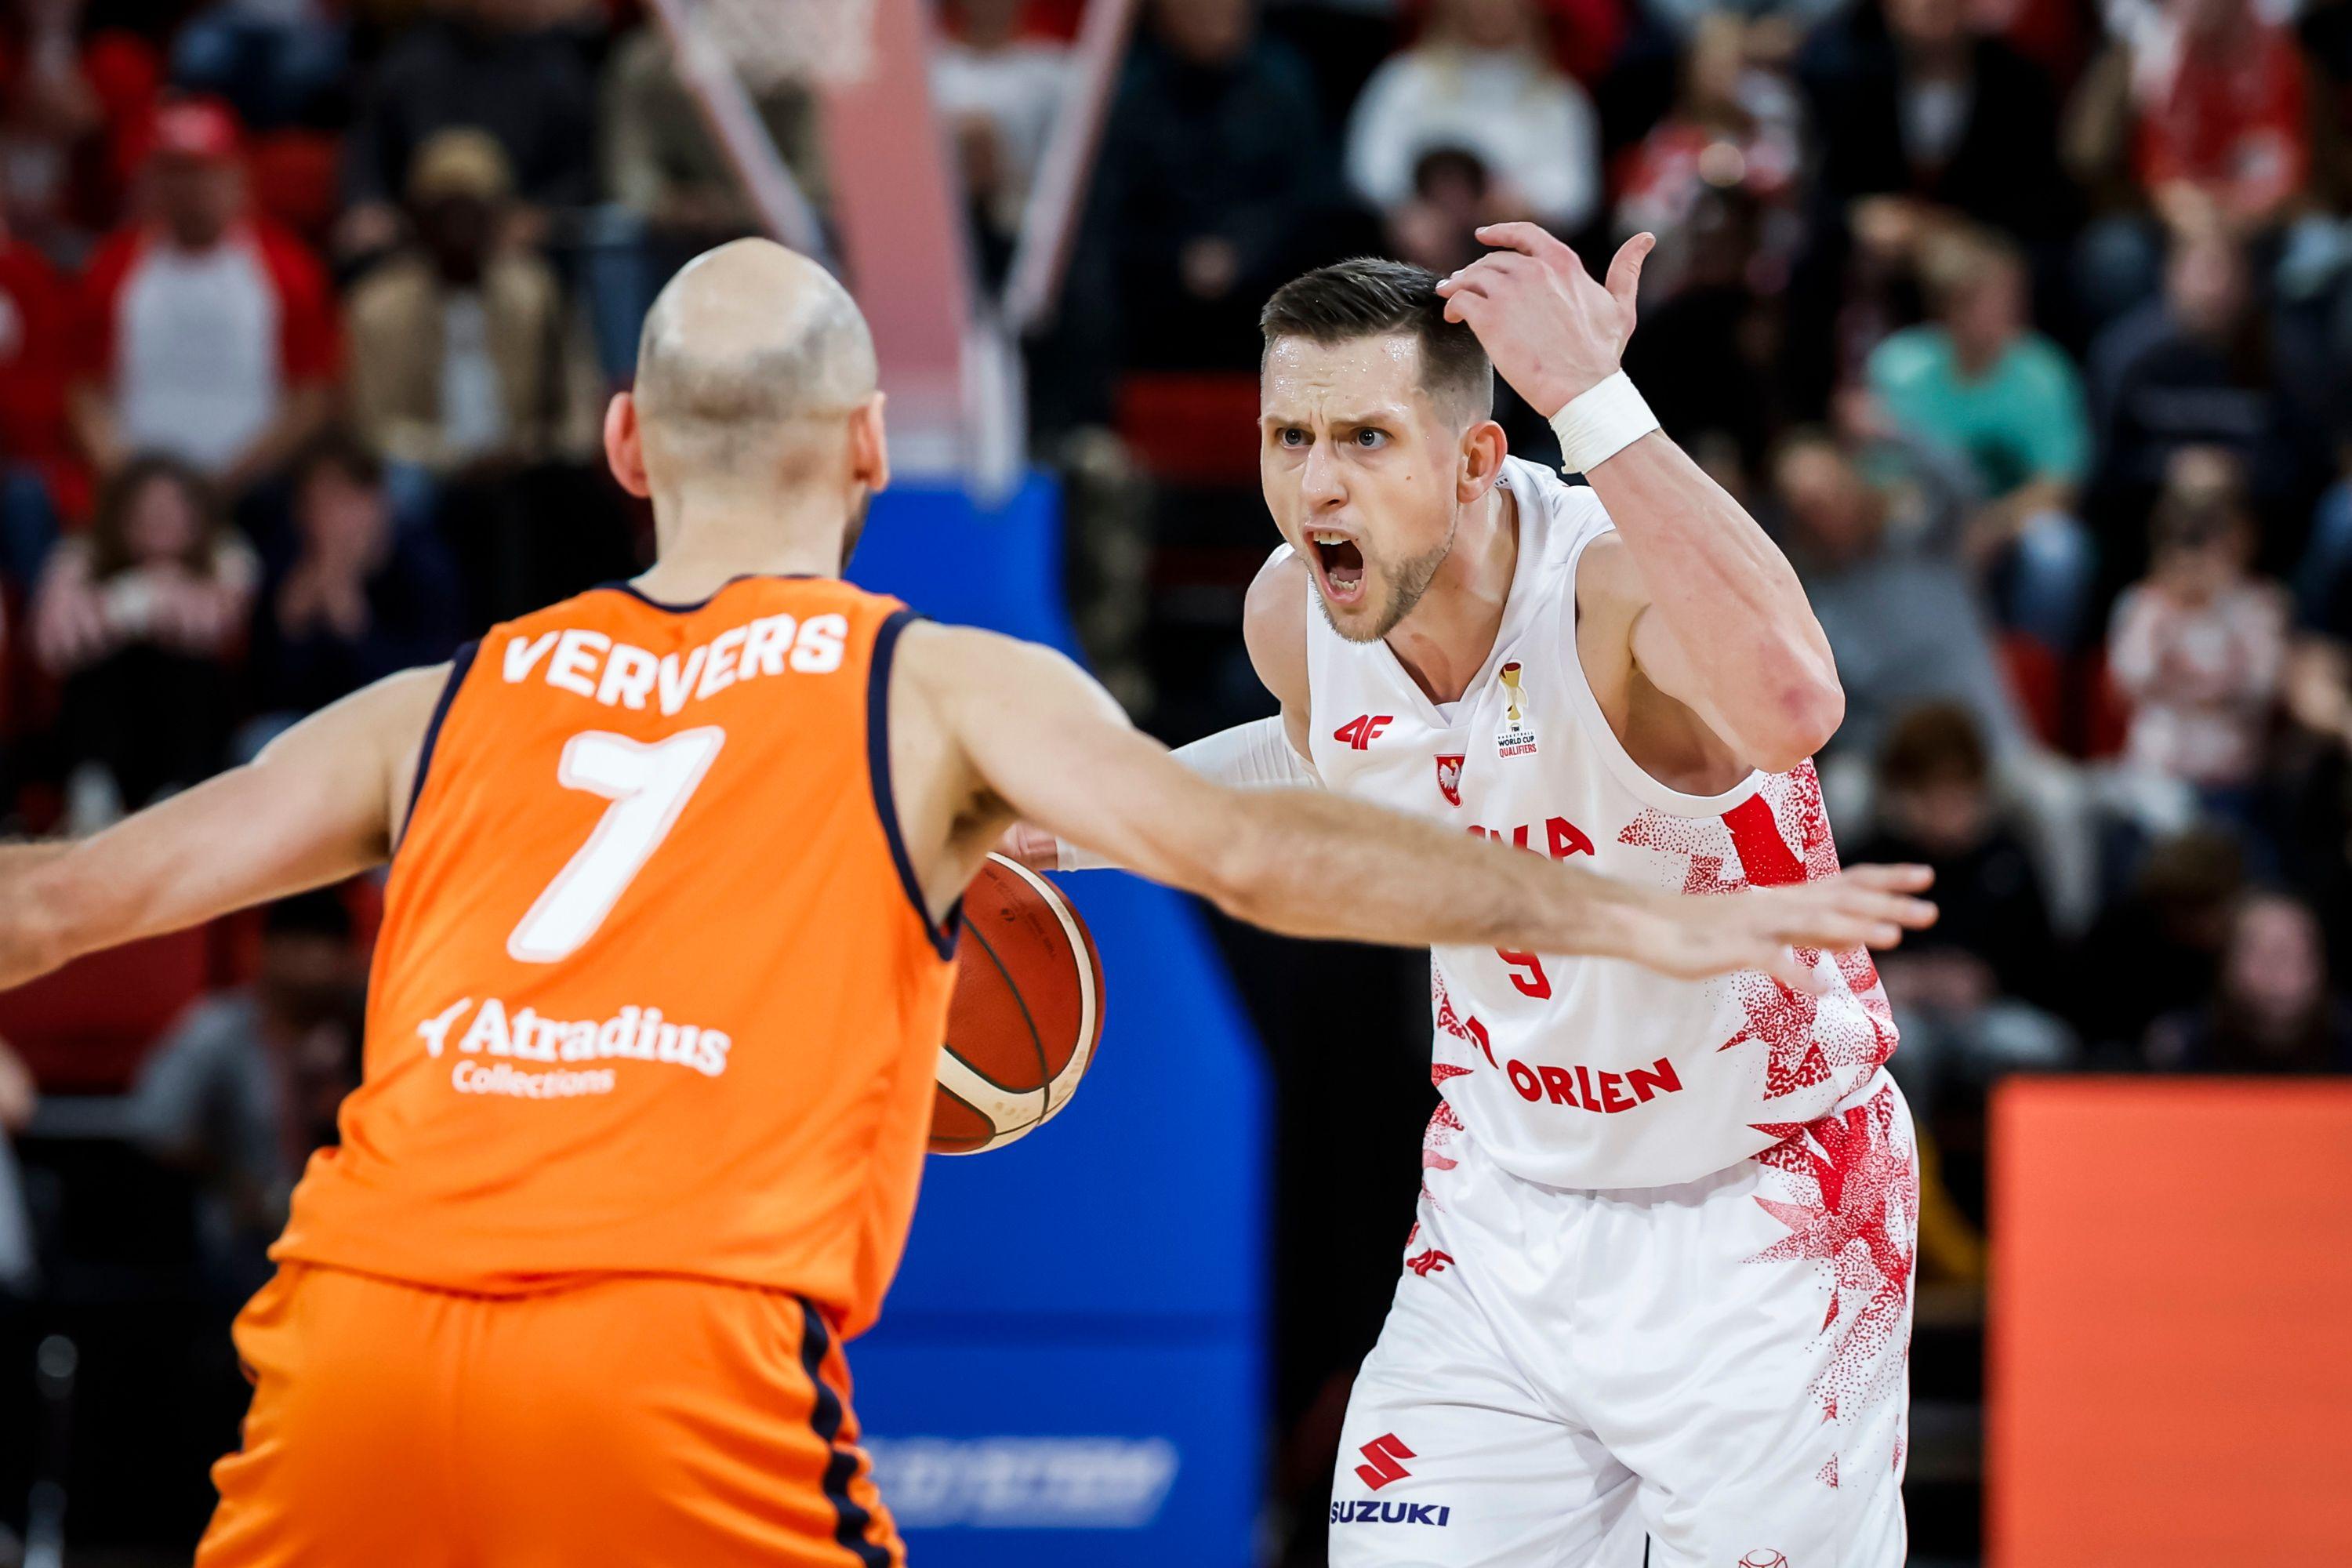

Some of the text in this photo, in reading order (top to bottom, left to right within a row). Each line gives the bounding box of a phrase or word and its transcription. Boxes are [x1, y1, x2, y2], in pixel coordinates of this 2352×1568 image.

[503, 612, 848, 716] VERVERS
[1334, 714, 1394, 750] 4F
[1498, 737, 1522, 746] WORLD
[1499, 743, 1537, 758] QUALIFIERS
[506, 725, 726, 964] 7
[459, 997, 731, 1077] Atradius
[452, 1059, 617, 1098] Collections
[1507, 1057, 1683, 1114] ORLEN
[1330, 1501, 1450, 1526] SUZUKI
